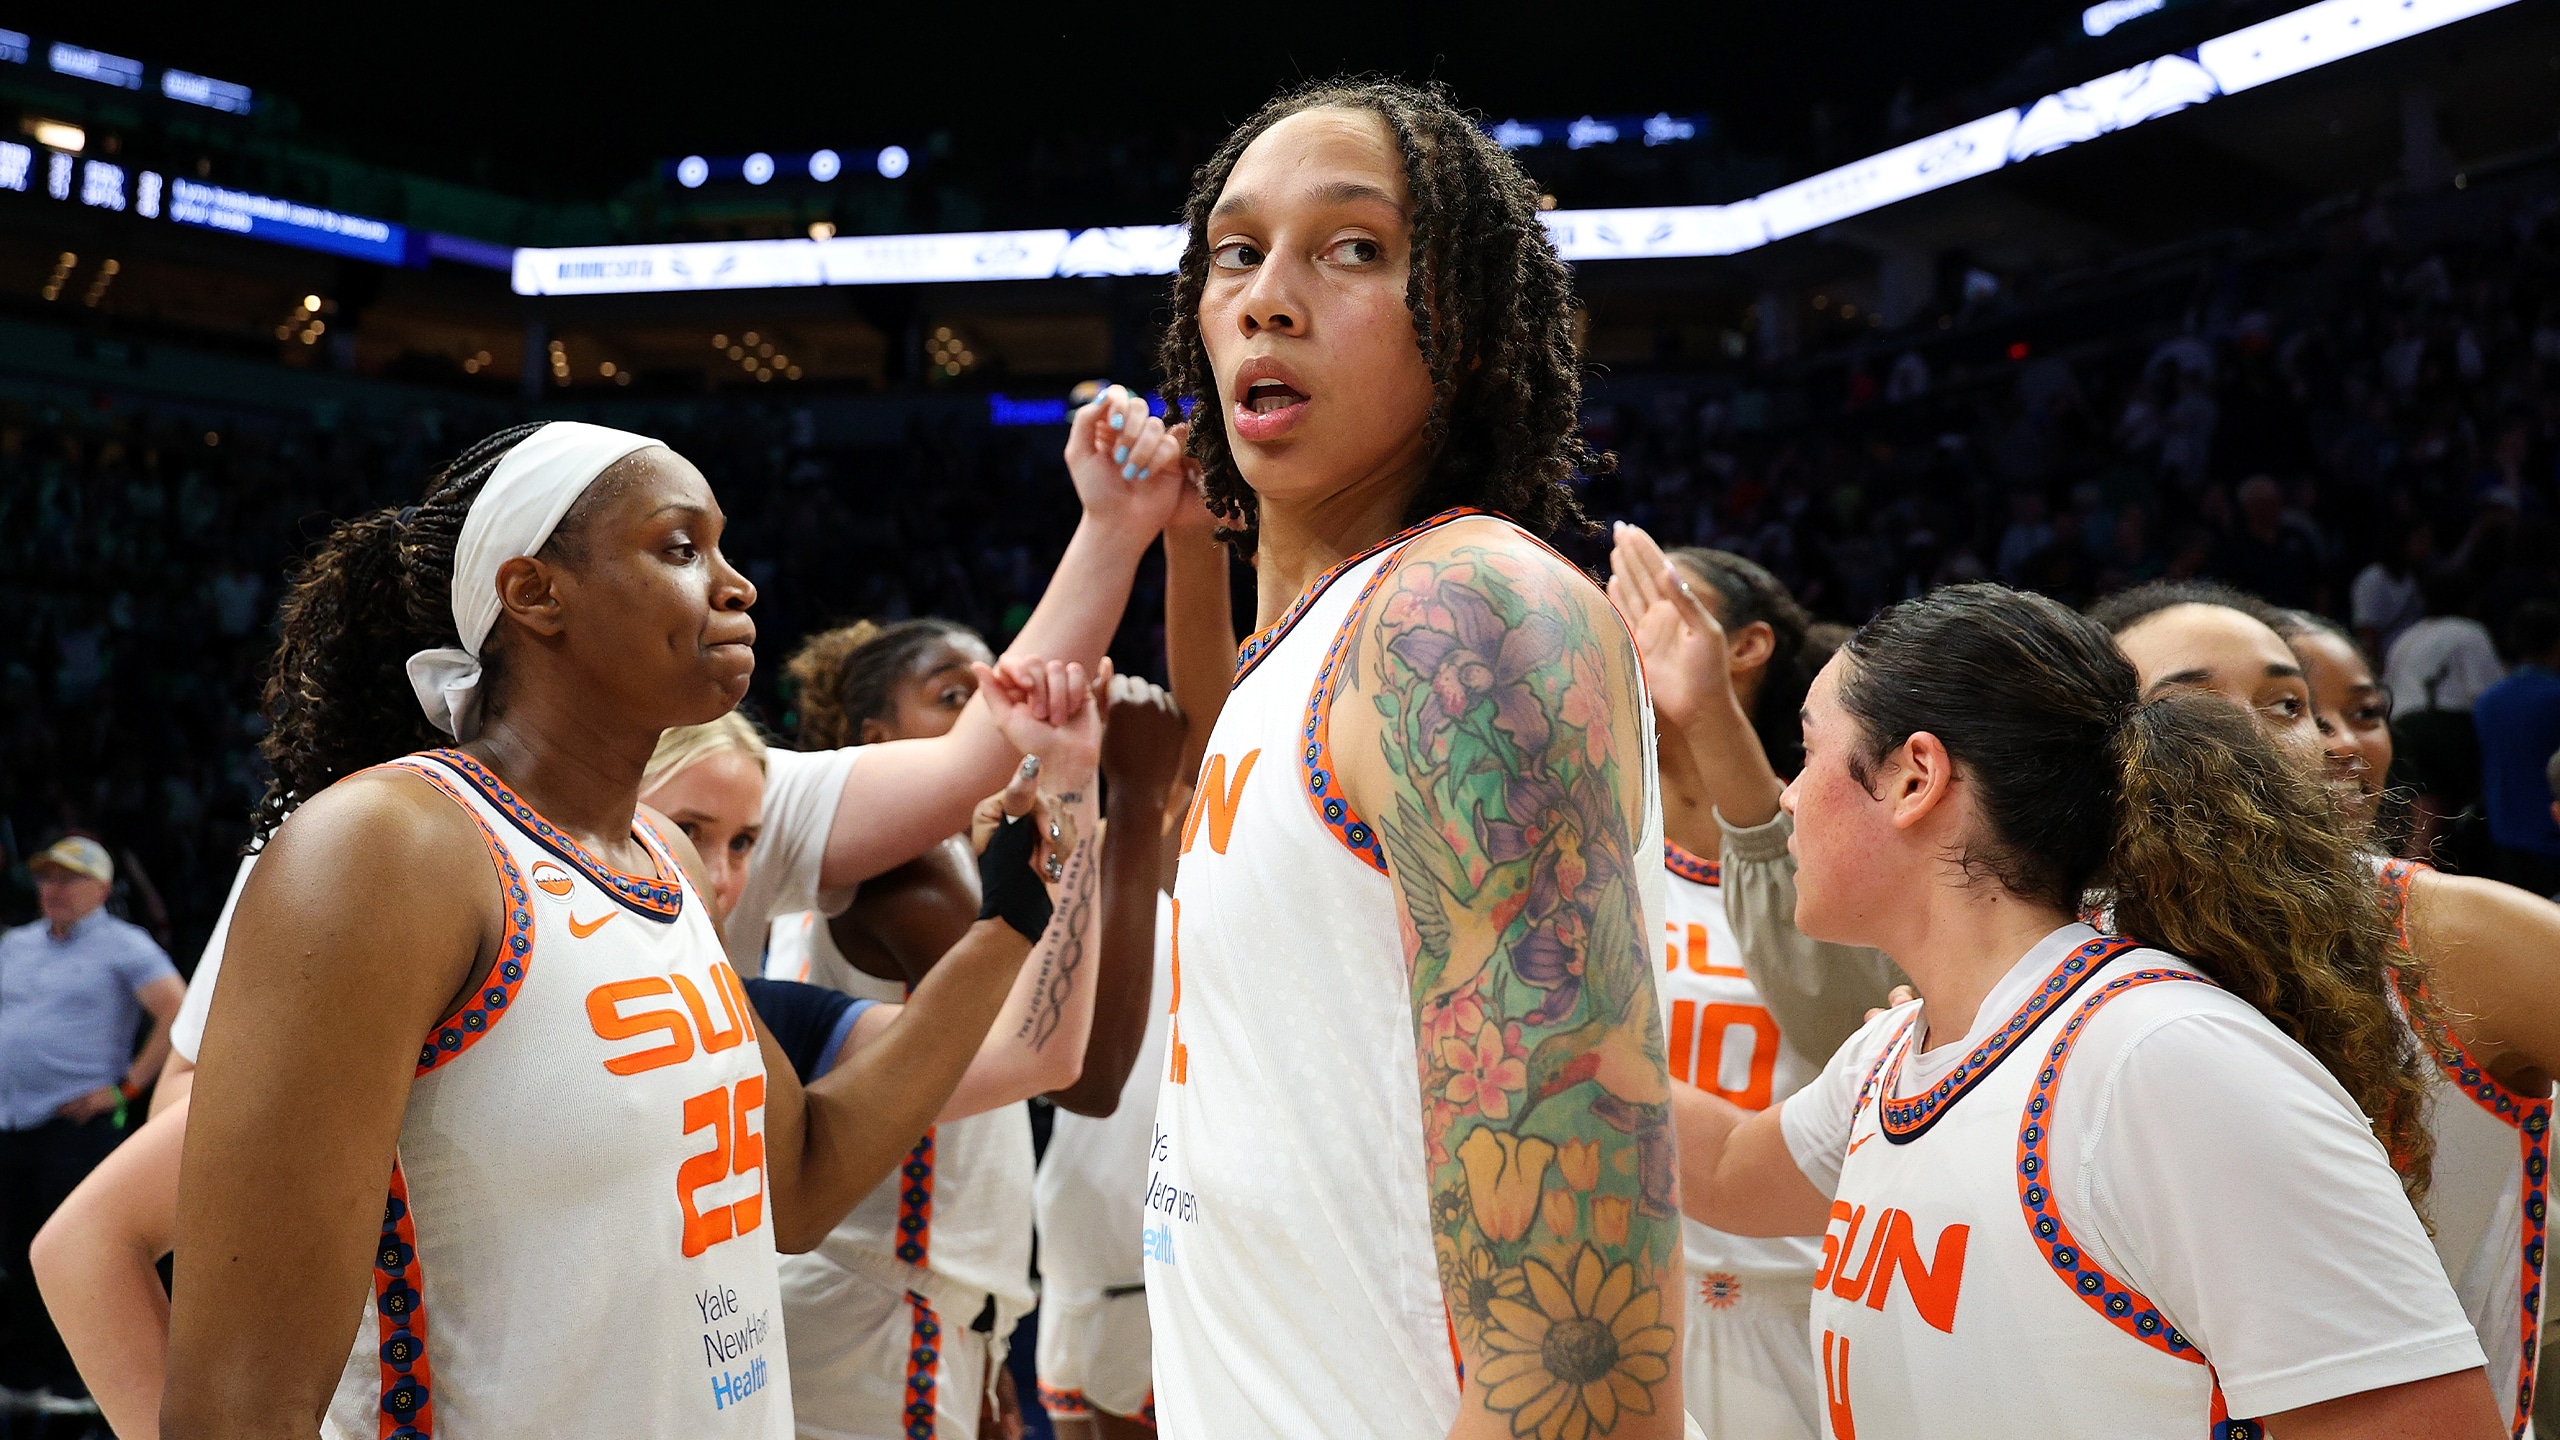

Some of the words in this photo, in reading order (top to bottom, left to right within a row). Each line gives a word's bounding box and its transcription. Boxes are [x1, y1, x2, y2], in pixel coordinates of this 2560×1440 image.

[676, 1074, 766, 1258] 25
[1142, 1223, 1176, 1266] ealth
[1812, 1199, 1971, 1335] SUN
[695, 1284, 739, 1325] Yale
[711, 1354, 768, 1411] Health
